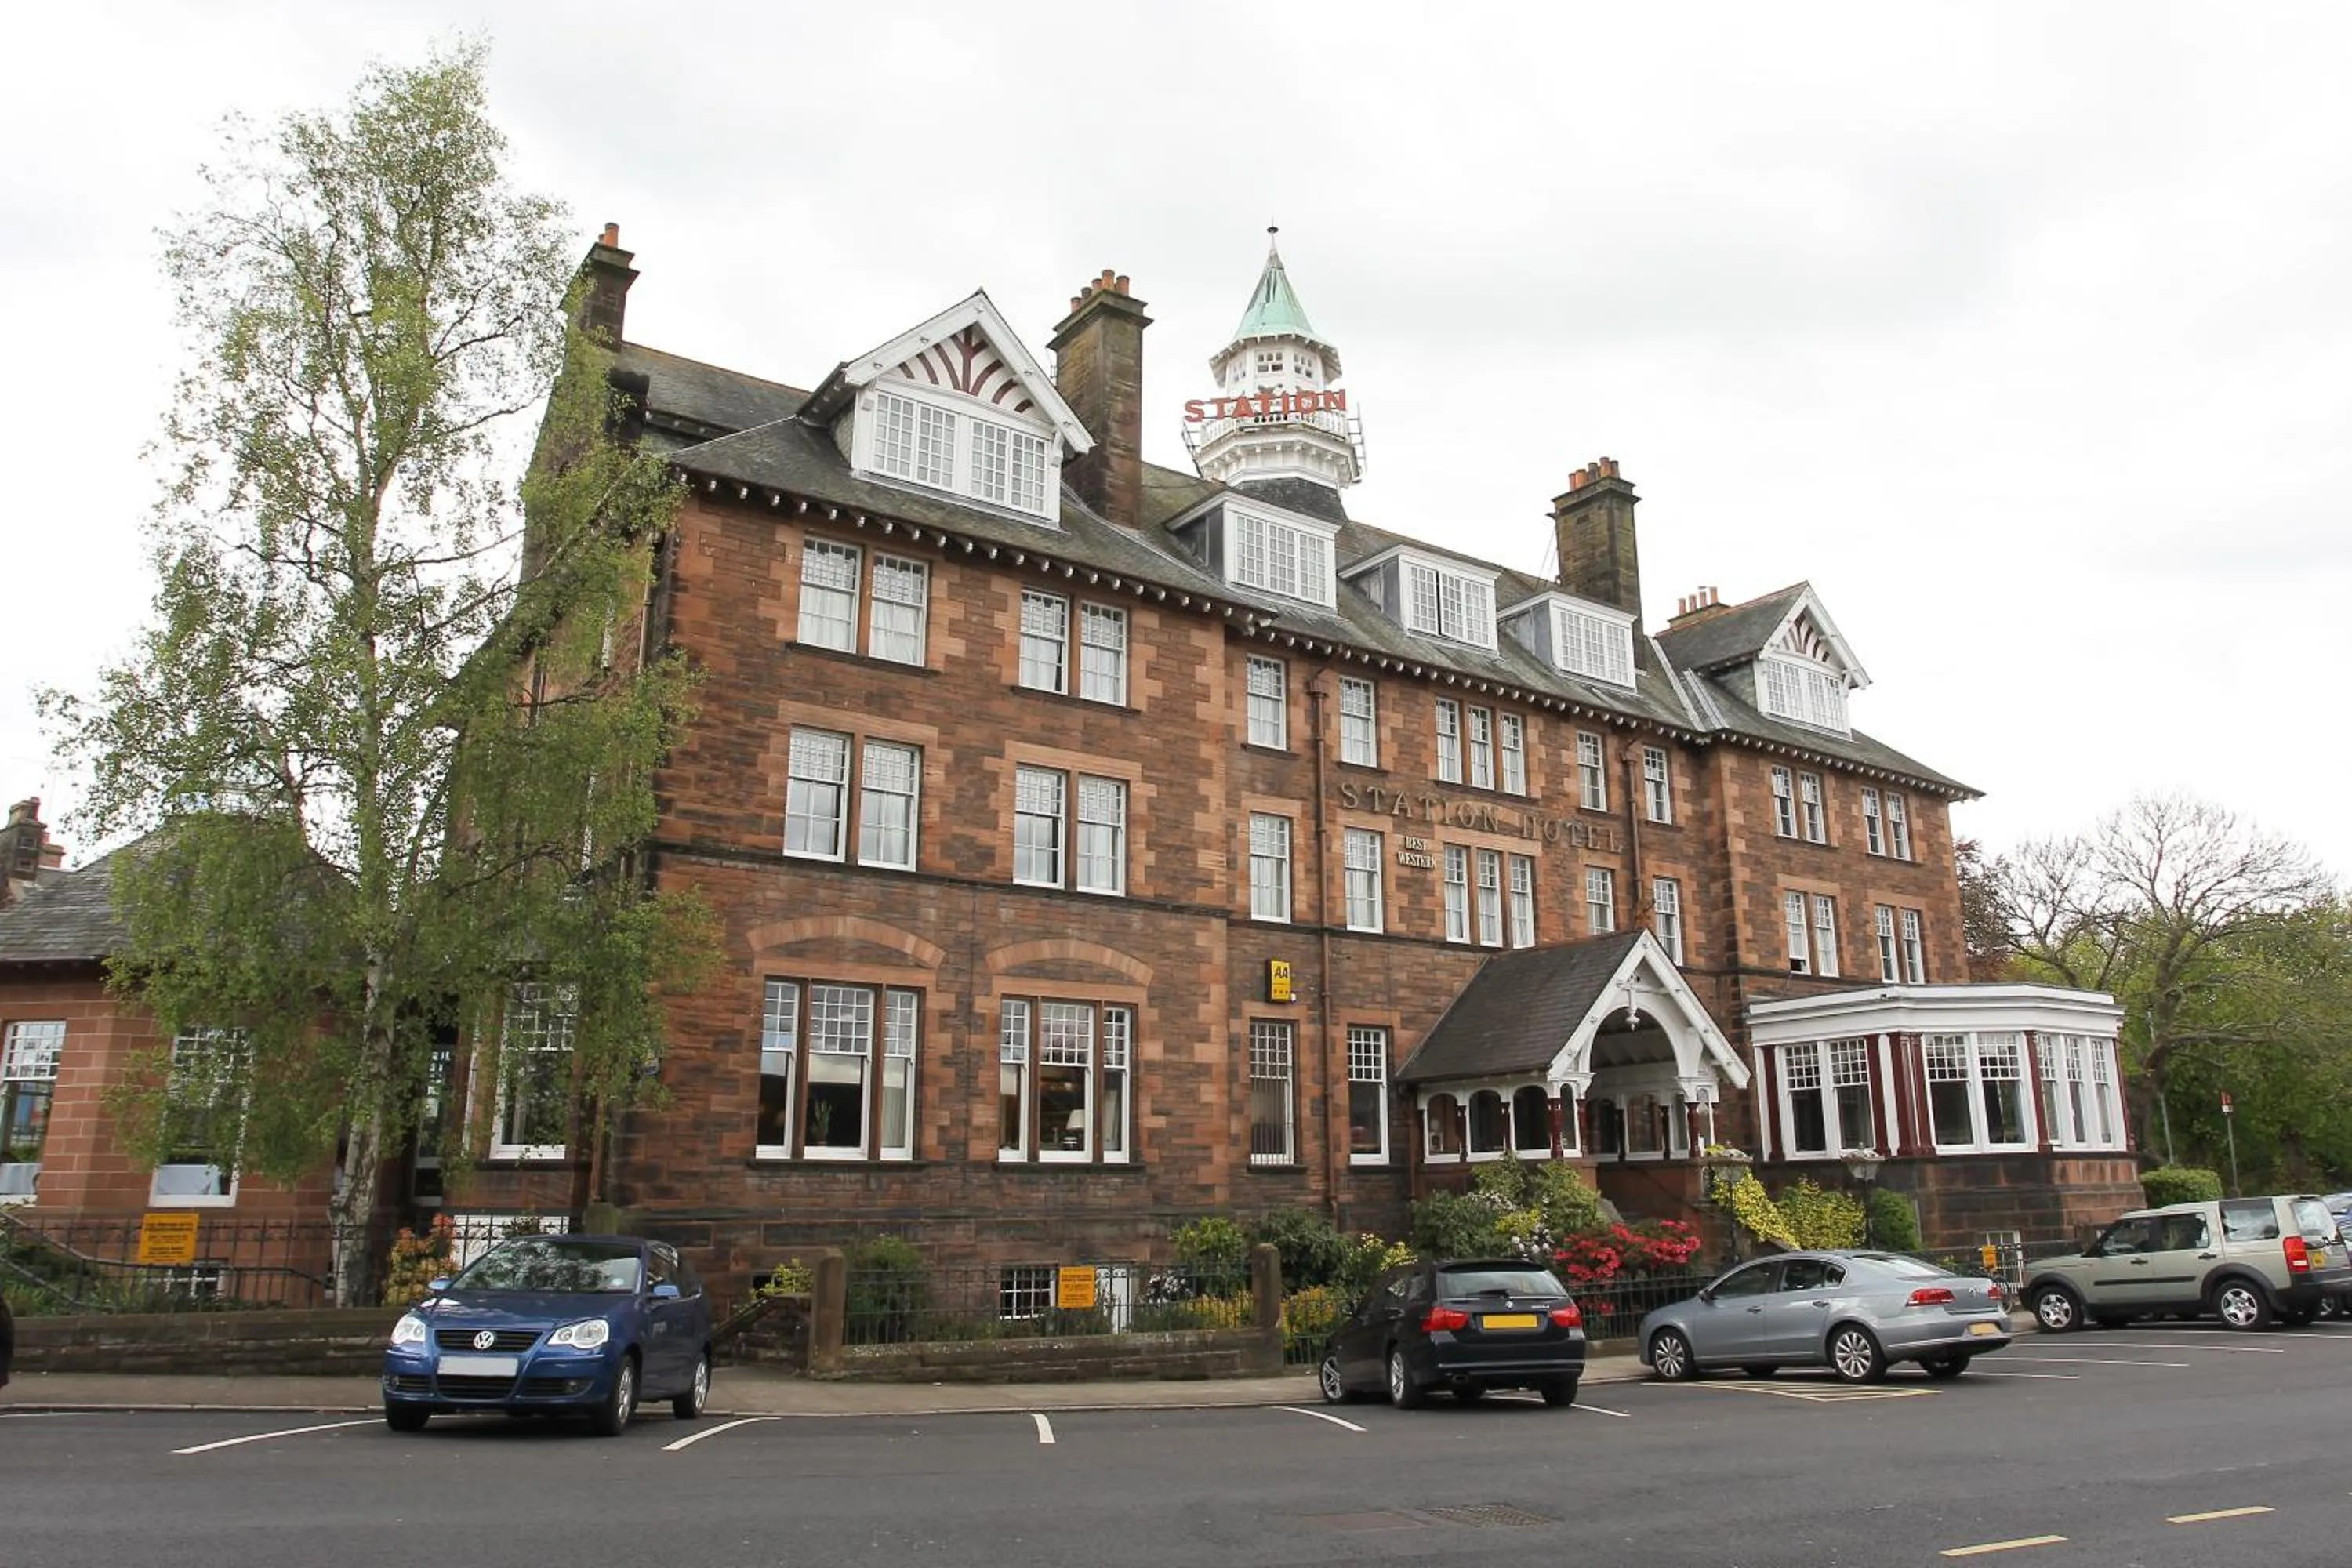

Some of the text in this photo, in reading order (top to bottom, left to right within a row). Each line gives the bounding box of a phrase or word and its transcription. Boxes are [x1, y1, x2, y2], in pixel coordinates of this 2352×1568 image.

[1185, 389, 1346, 423] STATION
[1340, 783, 1624, 855] STATION HOTEL
[1274, 965, 1288, 979] AA
